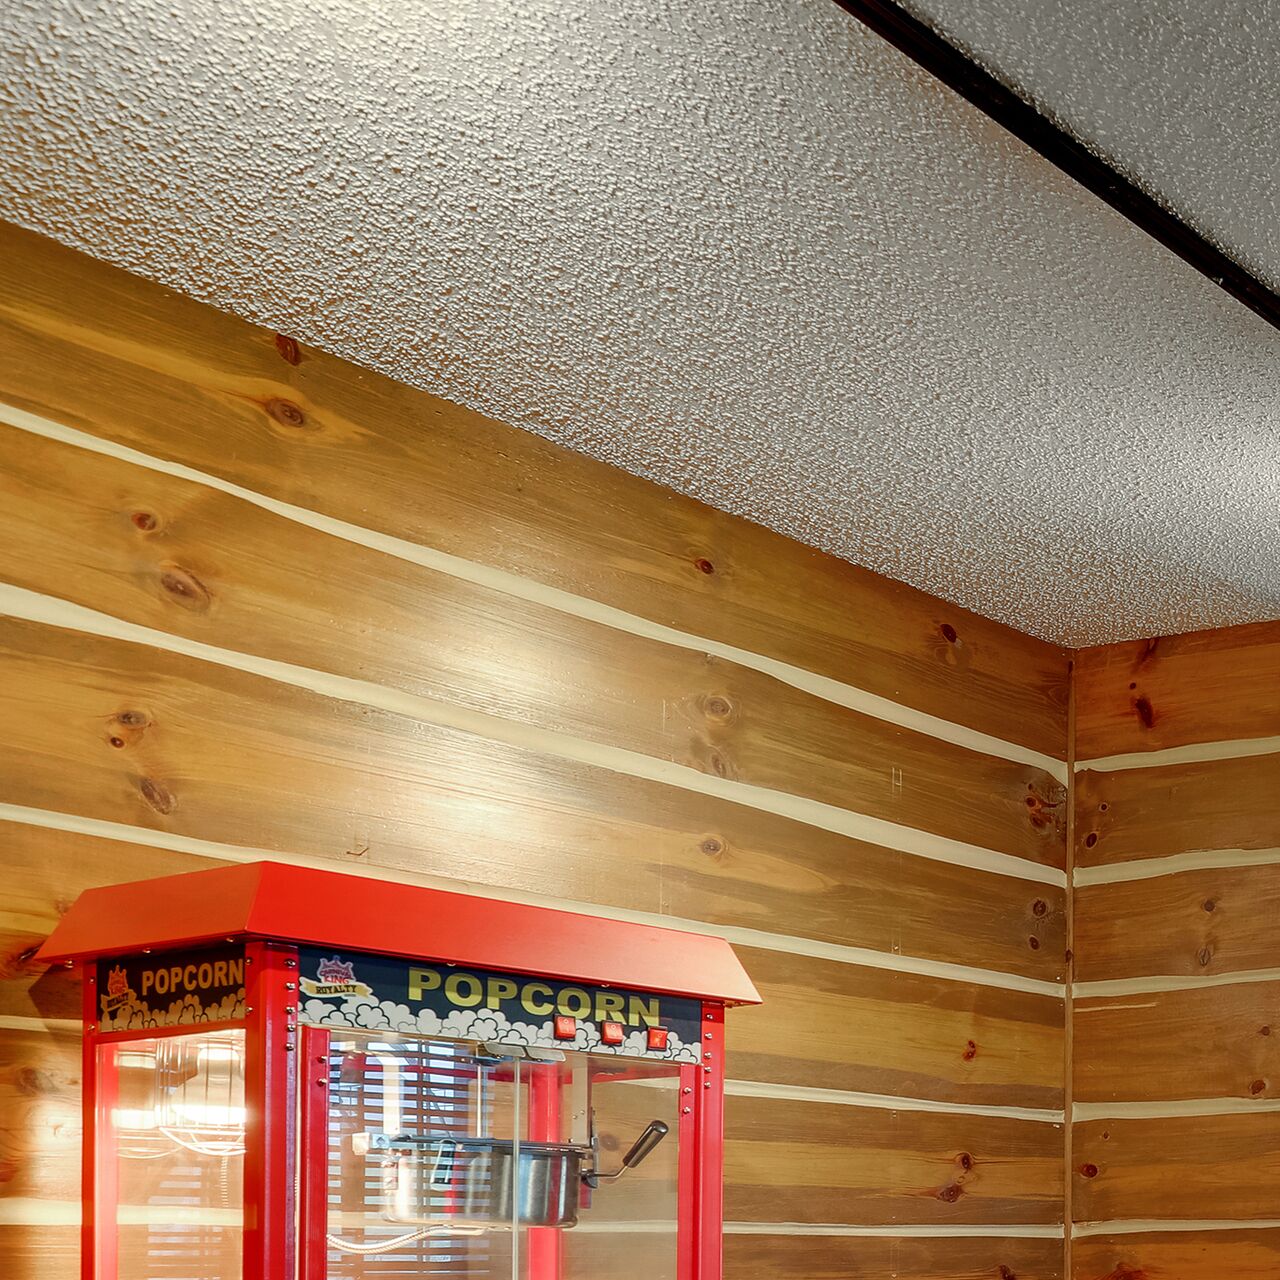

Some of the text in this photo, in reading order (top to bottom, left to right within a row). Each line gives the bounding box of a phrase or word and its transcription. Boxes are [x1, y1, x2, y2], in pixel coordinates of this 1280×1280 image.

[142, 958, 243, 996] POPCORN
[315, 984, 357, 995] ROYALTY
[408, 966, 660, 1027] POPCORN
